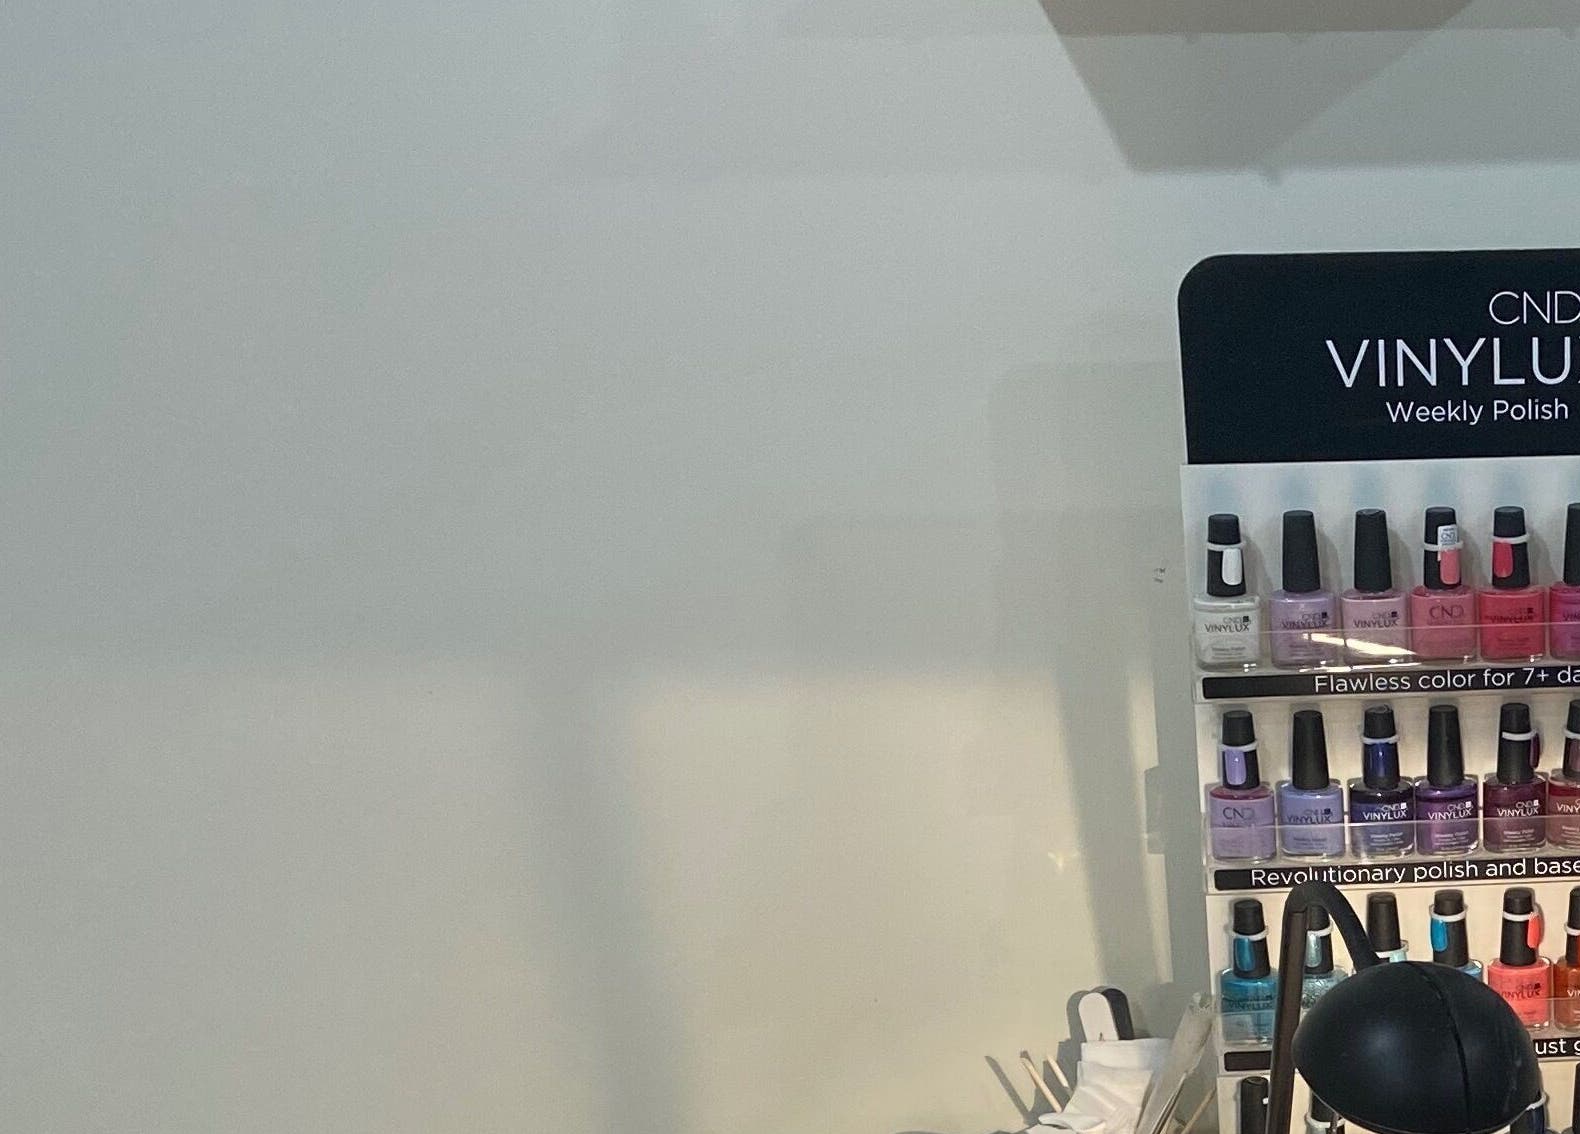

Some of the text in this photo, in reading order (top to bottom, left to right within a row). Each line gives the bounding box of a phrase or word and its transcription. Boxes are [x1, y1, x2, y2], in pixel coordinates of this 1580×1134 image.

[1385, 397, 1569, 425] Weekly Polish
[1429, 604, 1465, 620] CND
[1205, 623, 1249, 633] VINYLUX
[1281, 619, 1328, 629] VINYLUX
[1353, 618, 1398, 629] VINYLUX
[1314, 673, 1411, 693] Flawless
[1418, 669, 1476, 689] color
[1483, 668, 1515, 687] for
[1522, 667, 1549, 686] 7+
[1222, 806, 1255, 820] CND
[1362, 809, 1407, 821] VINYLUX
[1427, 809, 1472, 820] VINYLUX
[1496, 807, 1539, 817] VINYLUX
[1287, 815, 1331, 824] VINYLUX
[1251, 865, 1406, 887] Revolutionary
[1413, 860, 1479, 882] polish
[1485, 858, 1526, 877] and
[1535, 1037, 1567, 1056] ust
